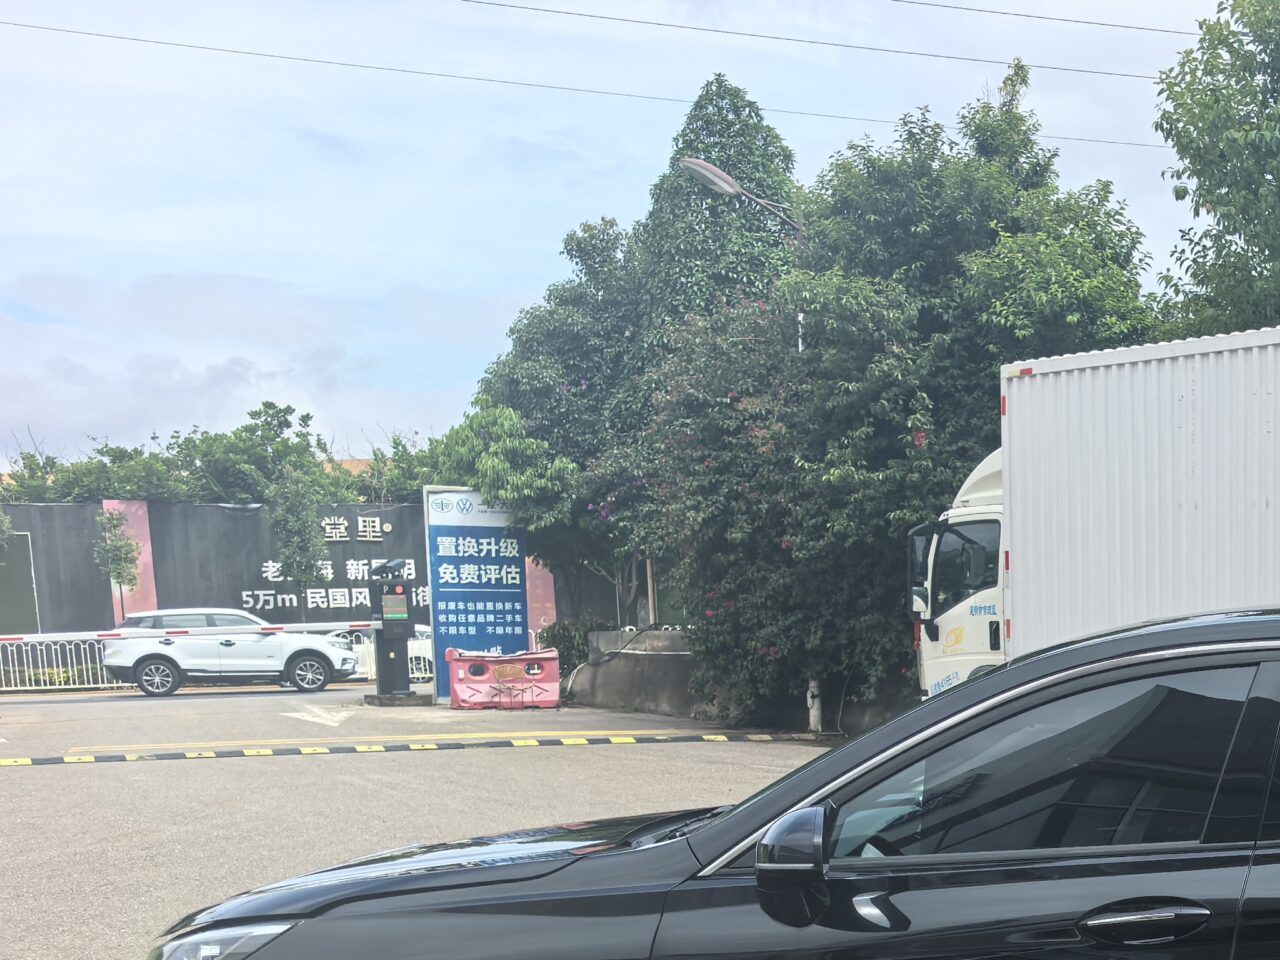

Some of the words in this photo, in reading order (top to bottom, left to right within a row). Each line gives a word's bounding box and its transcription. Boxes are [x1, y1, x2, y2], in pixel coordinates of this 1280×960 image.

[436, 536, 519, 558] 置换升级
[438, 563, 520, 585] 免费评估
[437, 601, 522, 611] 报废车也能置换新车
[438, 613, 523, 623] 收购任意品牌二手车
[439, 626, 477, 636] 不限车型
[486, 626, 523, 636] 不限年限
